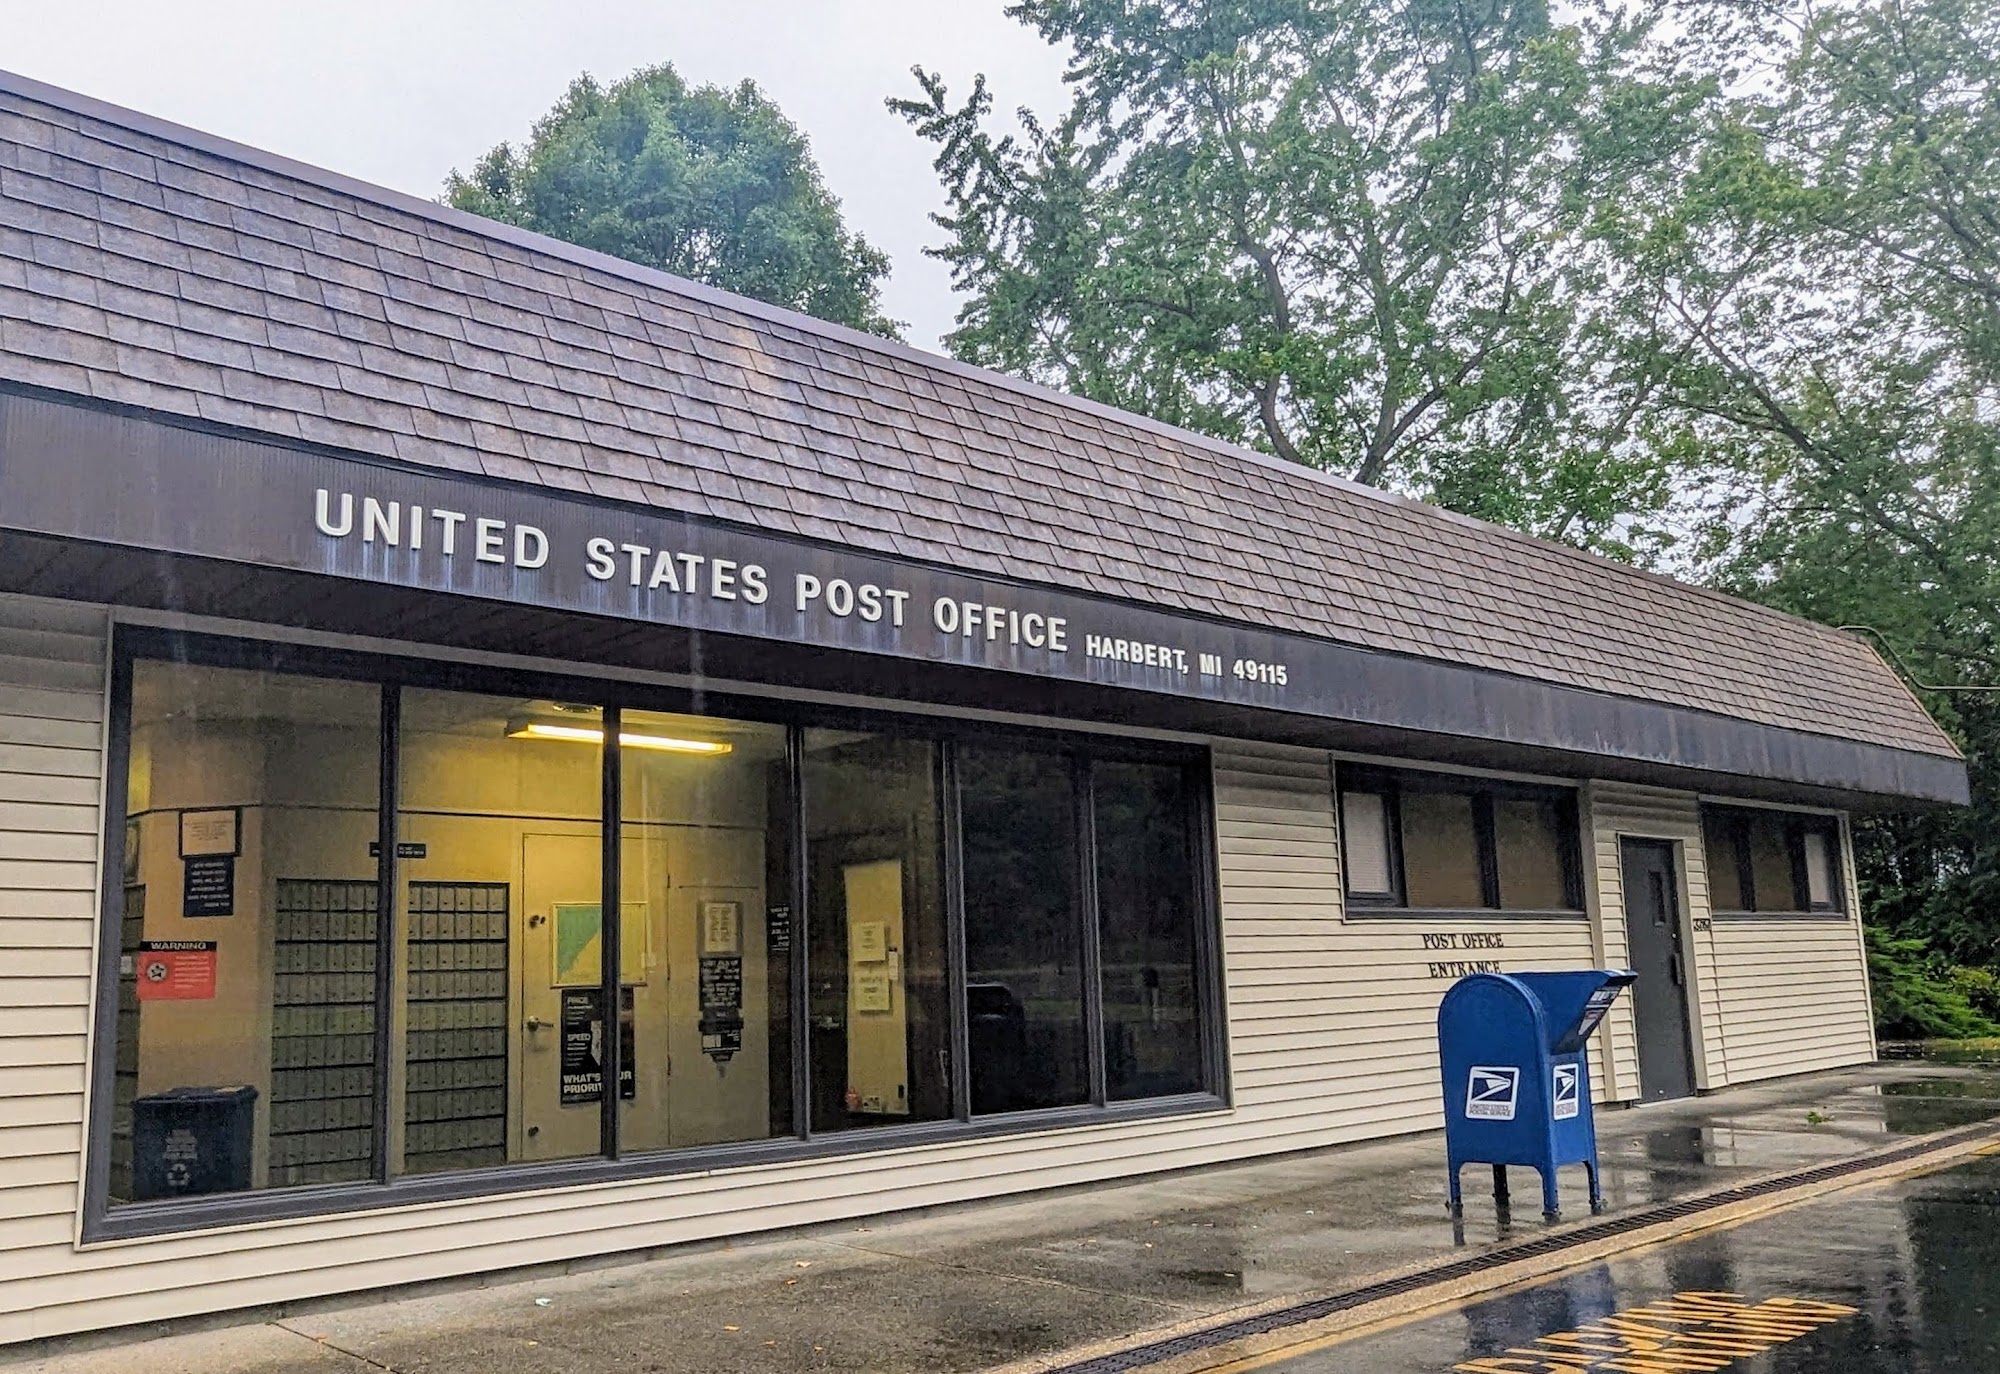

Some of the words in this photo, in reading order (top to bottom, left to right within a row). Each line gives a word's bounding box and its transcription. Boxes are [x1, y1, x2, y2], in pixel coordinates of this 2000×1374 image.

[315, 488, 549, 569] UNITED
[585, 538, 768, 604] STATES
[795, 573, 909, 626] POST
[933, 597, 1068, 652] OFFICE
[1086, 634, 1189, 675] HARBERT,
[1200, 652, 1222, 677] MI
[1232, 658, 1288, 686] 49115
[151, 942, 207, 950] WARNING
[1421, 933, 1456, 949] POST
[1462, 932, 1504, 948] OFFICE
[1427, 961, 1502, 978] ENTRANCE
[567, 1033, 591, 1042] SPEED
[563, 1073, 601, 1084] WHAT'S
[563, 1083, 602, 1094] PRIORIT
